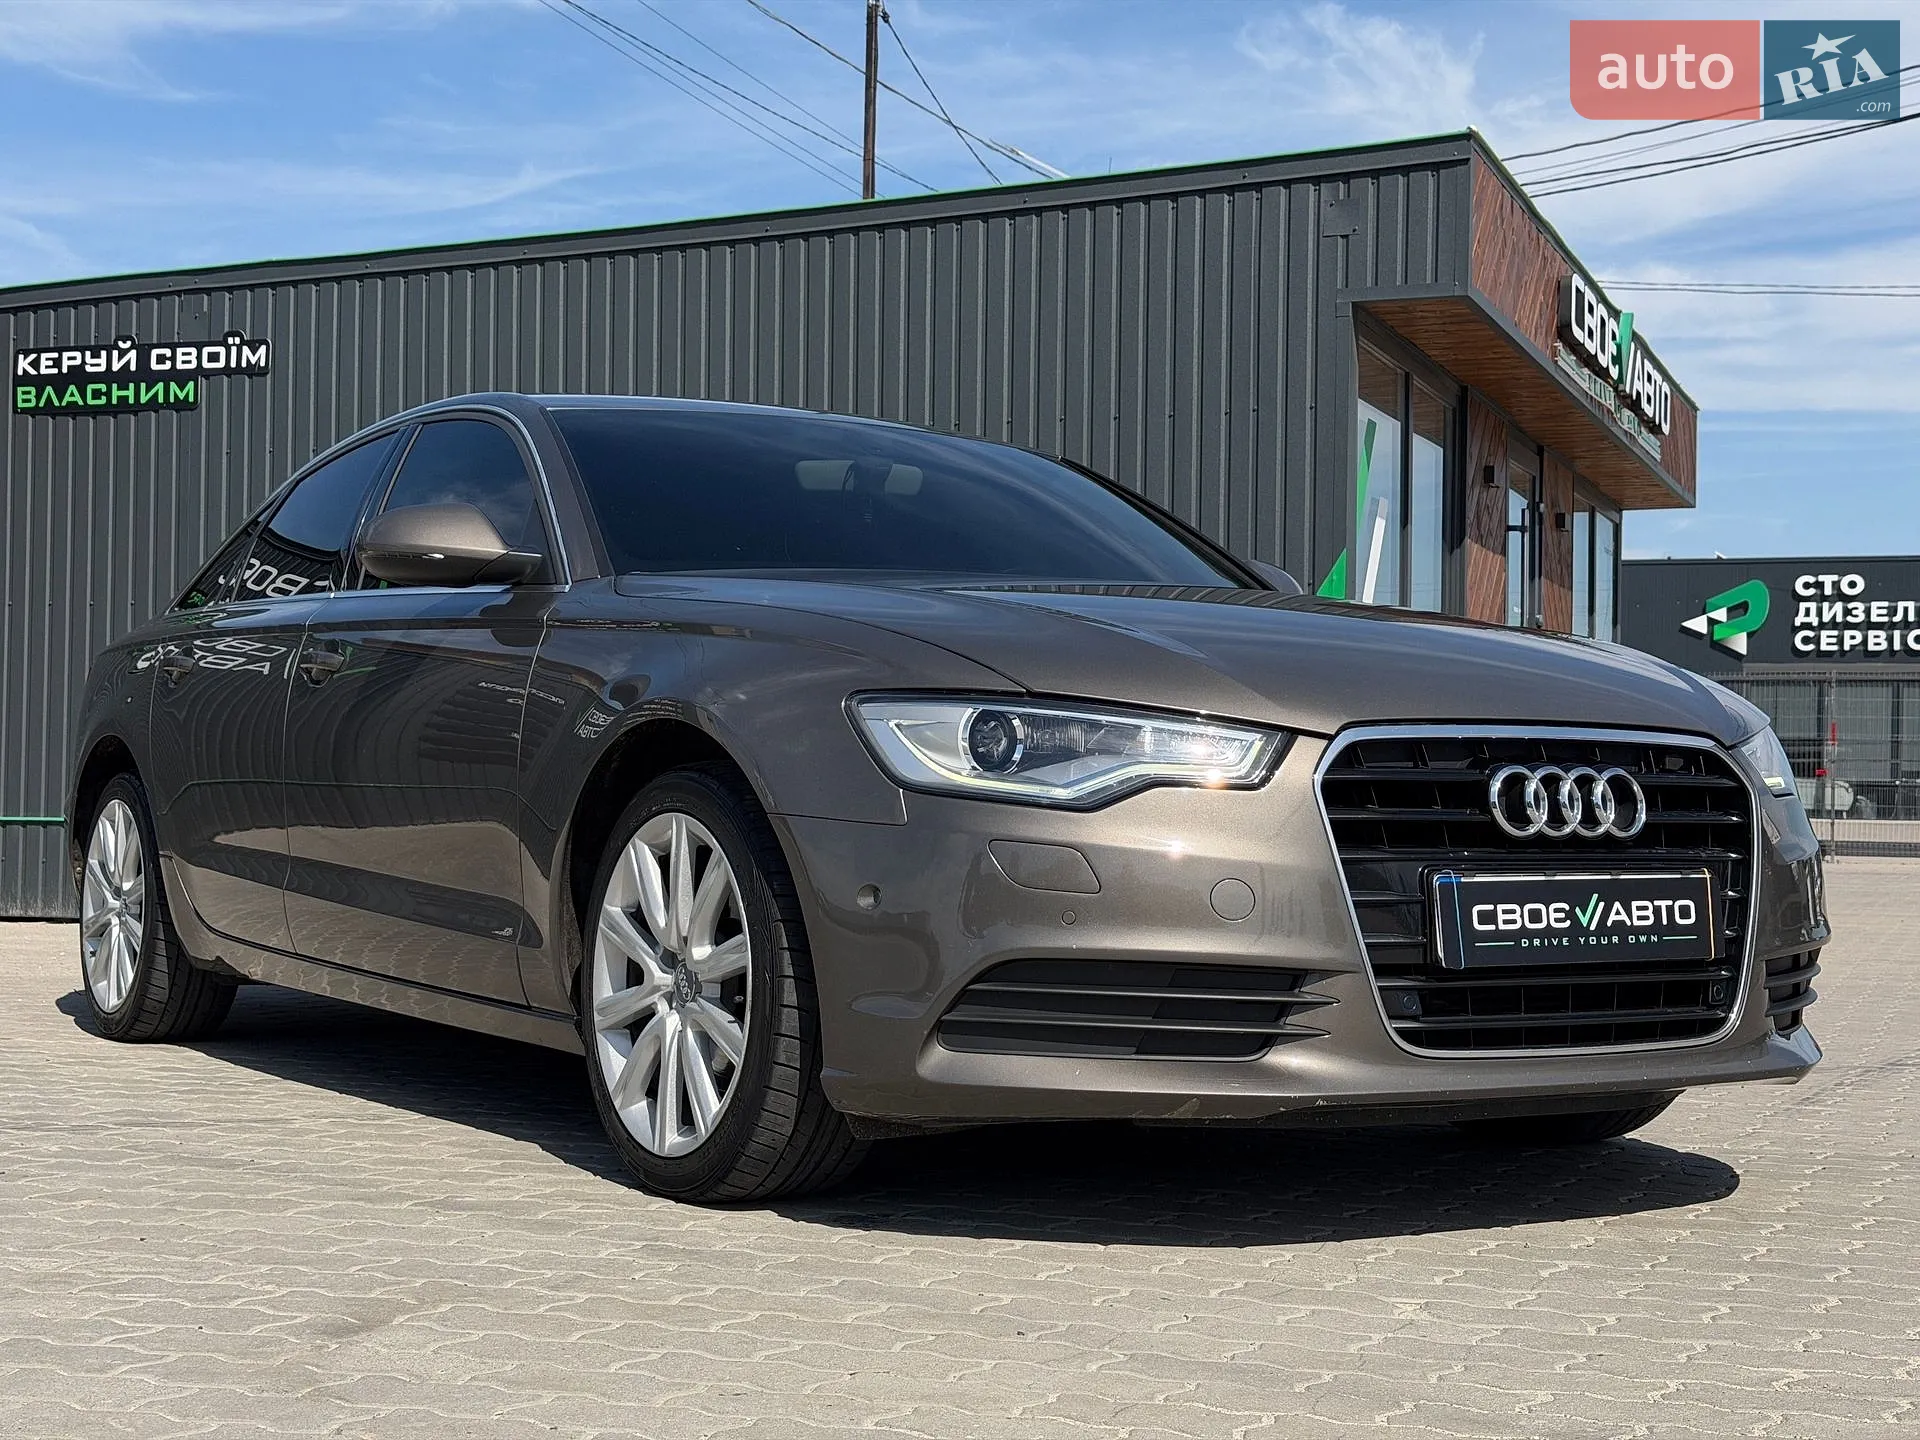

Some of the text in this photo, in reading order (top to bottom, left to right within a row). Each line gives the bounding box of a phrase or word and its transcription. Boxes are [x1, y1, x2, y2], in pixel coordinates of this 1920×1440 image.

[16, 336, 268, 376] КЕРУЙ СВОЇМ
[16, 380, 196, 409] ВЛАСНИМ
[1632, 349, 1671, 436] АВТО
[1794, 573, 1866, 598] СТО
[1606, 899, 1697, 927] АВТО
[1521, 934, 1659, 947] DRIVE YOUR OWN
